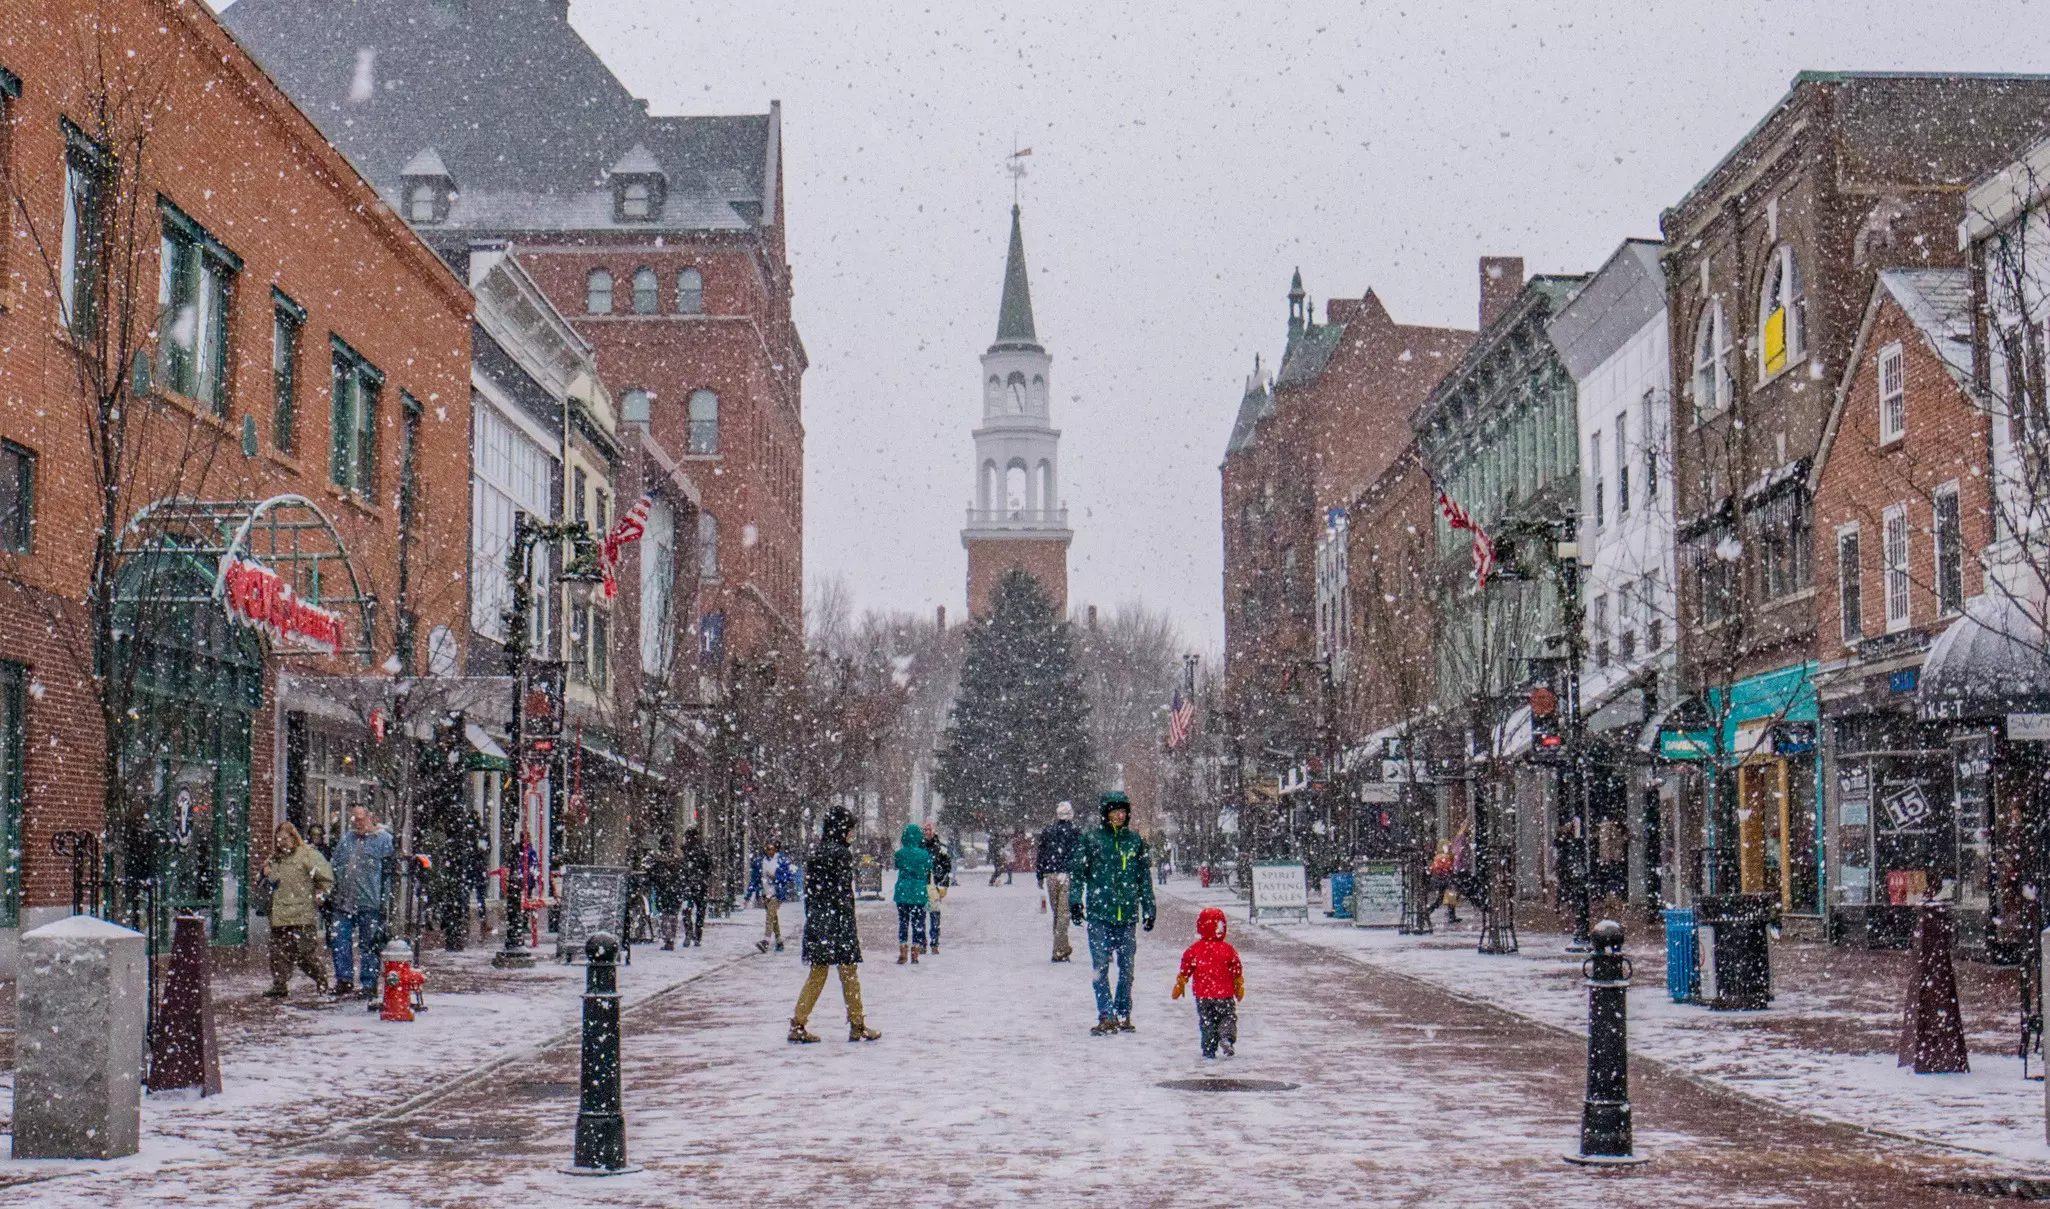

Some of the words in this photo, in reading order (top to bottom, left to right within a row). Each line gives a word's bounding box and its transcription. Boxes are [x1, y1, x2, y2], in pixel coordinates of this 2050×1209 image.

[1890, 791, 1924, 824] 15
[1261, 871, 1296, 879] SPIRIT
[1257, 882, 1304, 890] TASTING
[1272, 893, 1302, 901] SALES
